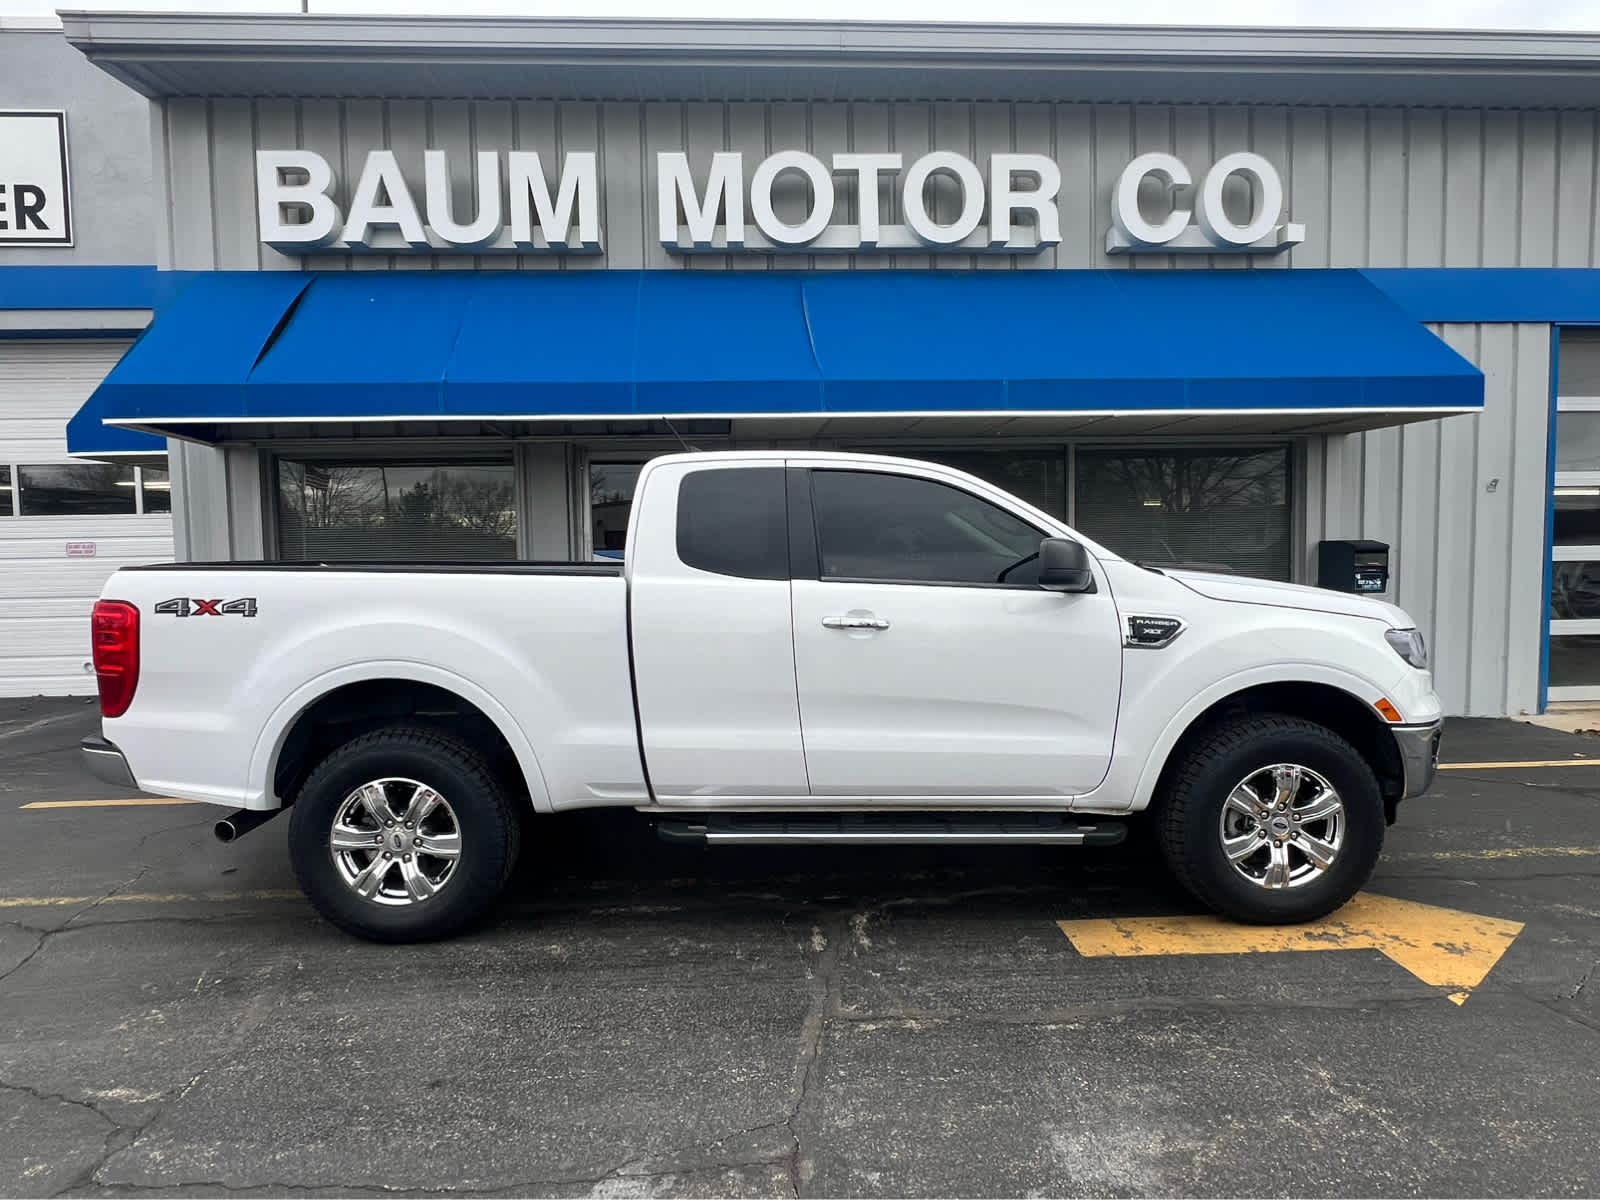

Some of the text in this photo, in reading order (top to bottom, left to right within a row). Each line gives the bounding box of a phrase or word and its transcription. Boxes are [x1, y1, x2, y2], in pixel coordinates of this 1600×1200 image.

[256, 149, 1306, 246] BAUM MOTOR CO.
